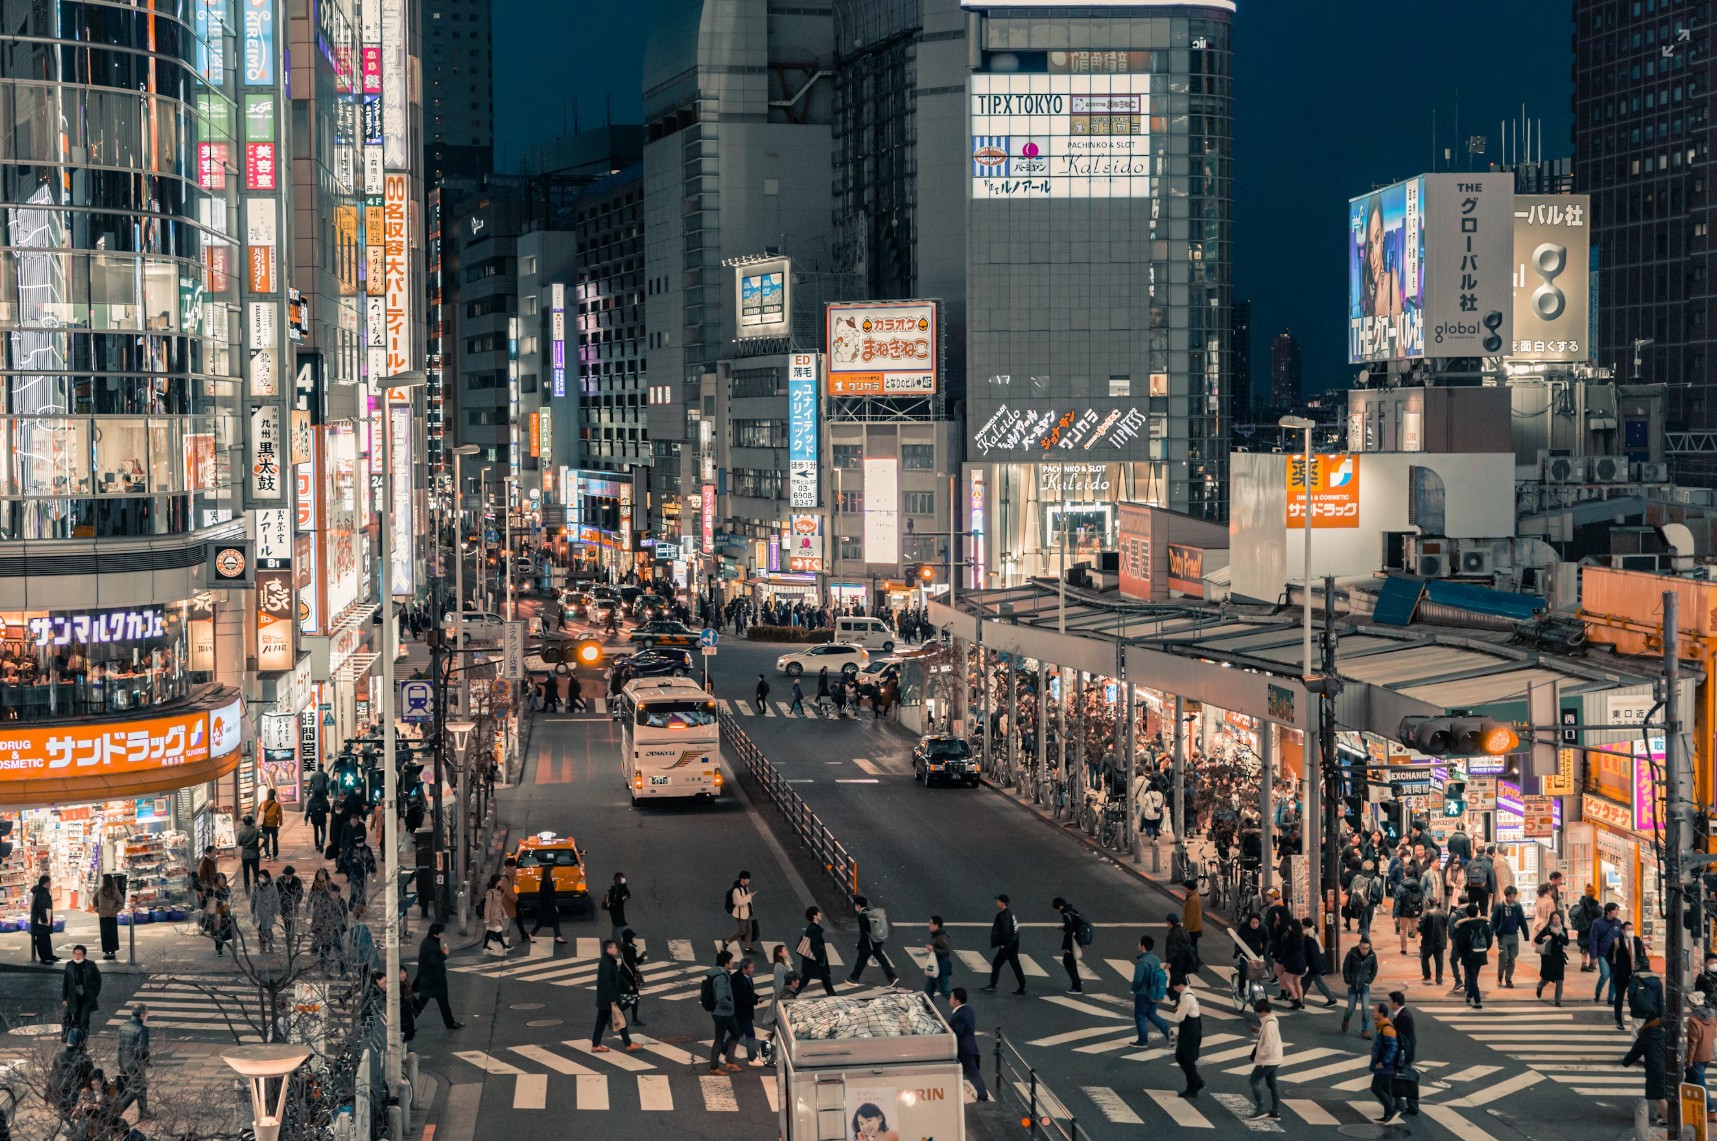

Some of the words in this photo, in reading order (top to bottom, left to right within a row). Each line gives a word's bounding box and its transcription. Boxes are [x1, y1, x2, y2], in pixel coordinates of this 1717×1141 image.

[1015, 94, 1063, 114] TOKYO
[1091, 123, 1140, 133] ワンカラ
[256, 145, 272, 187] 美容室
[1014, 164, 1047, 172] バーミヤン
[1058, 153, 1144, 176] Kaleido
[1001, 180, 1052, 194] ルノアール
[1457, 183, 1482, 193] THE
[367, 197, 382, 206] 4F
[1459, 197, 1478, 312] グローバル社
[371, 250, 380, 292] とりえもん
[873, 317, 917, 332] カラオケ
[1434, 321, 1480, 344] global
[861, 338, 930, 364] まねきねこ
[795, 355, 811, 365] ED
[793, 367, 812, 378] 薄毛
[835, 381, 844, 391] 1
[848, 382, 880, 391] ワンカラ
[885, 377, 916, 388] となりのビル
[793, 390, 803, 451] クリニック
[803, 385, 814, 458] ユナイテッド
[974, 419, 995, 442] PACHINKO
[995, 403, 1008, 418] SLOT
[976, 410, 1021, 456] Kaleido
[1040, 409, 1075, 450] ジョナサン
[1059, 408, 1099, 450] ワンカラ
[1109, 410, 1146, 449] TIPNESS
[791, 462, 817, 470] 徒歩1分
[1291, 459, 1319, 487] 薬
[793, 492, 815, 500] 6908-
[794, 499, 814, 507] 8347
[268, 559, 280, 568] B1
[803, 558, 820, 570] すぐ
[1119, 534, 1151, 582] 大黒屋
[509, 624, 518, 677] スクランブル交差点
[0, 740, 31, 750] DRUG
[46, 724, 186, 768] サンドラッグ
[302, 711, 316, 772] 時間営業
[11, 751, 20, 760] &
[1391, 771, 1430, 780] EXCHANGE
[1469, 793, 1479, 805] 5
[1525, 818, 1536, 830] 5
